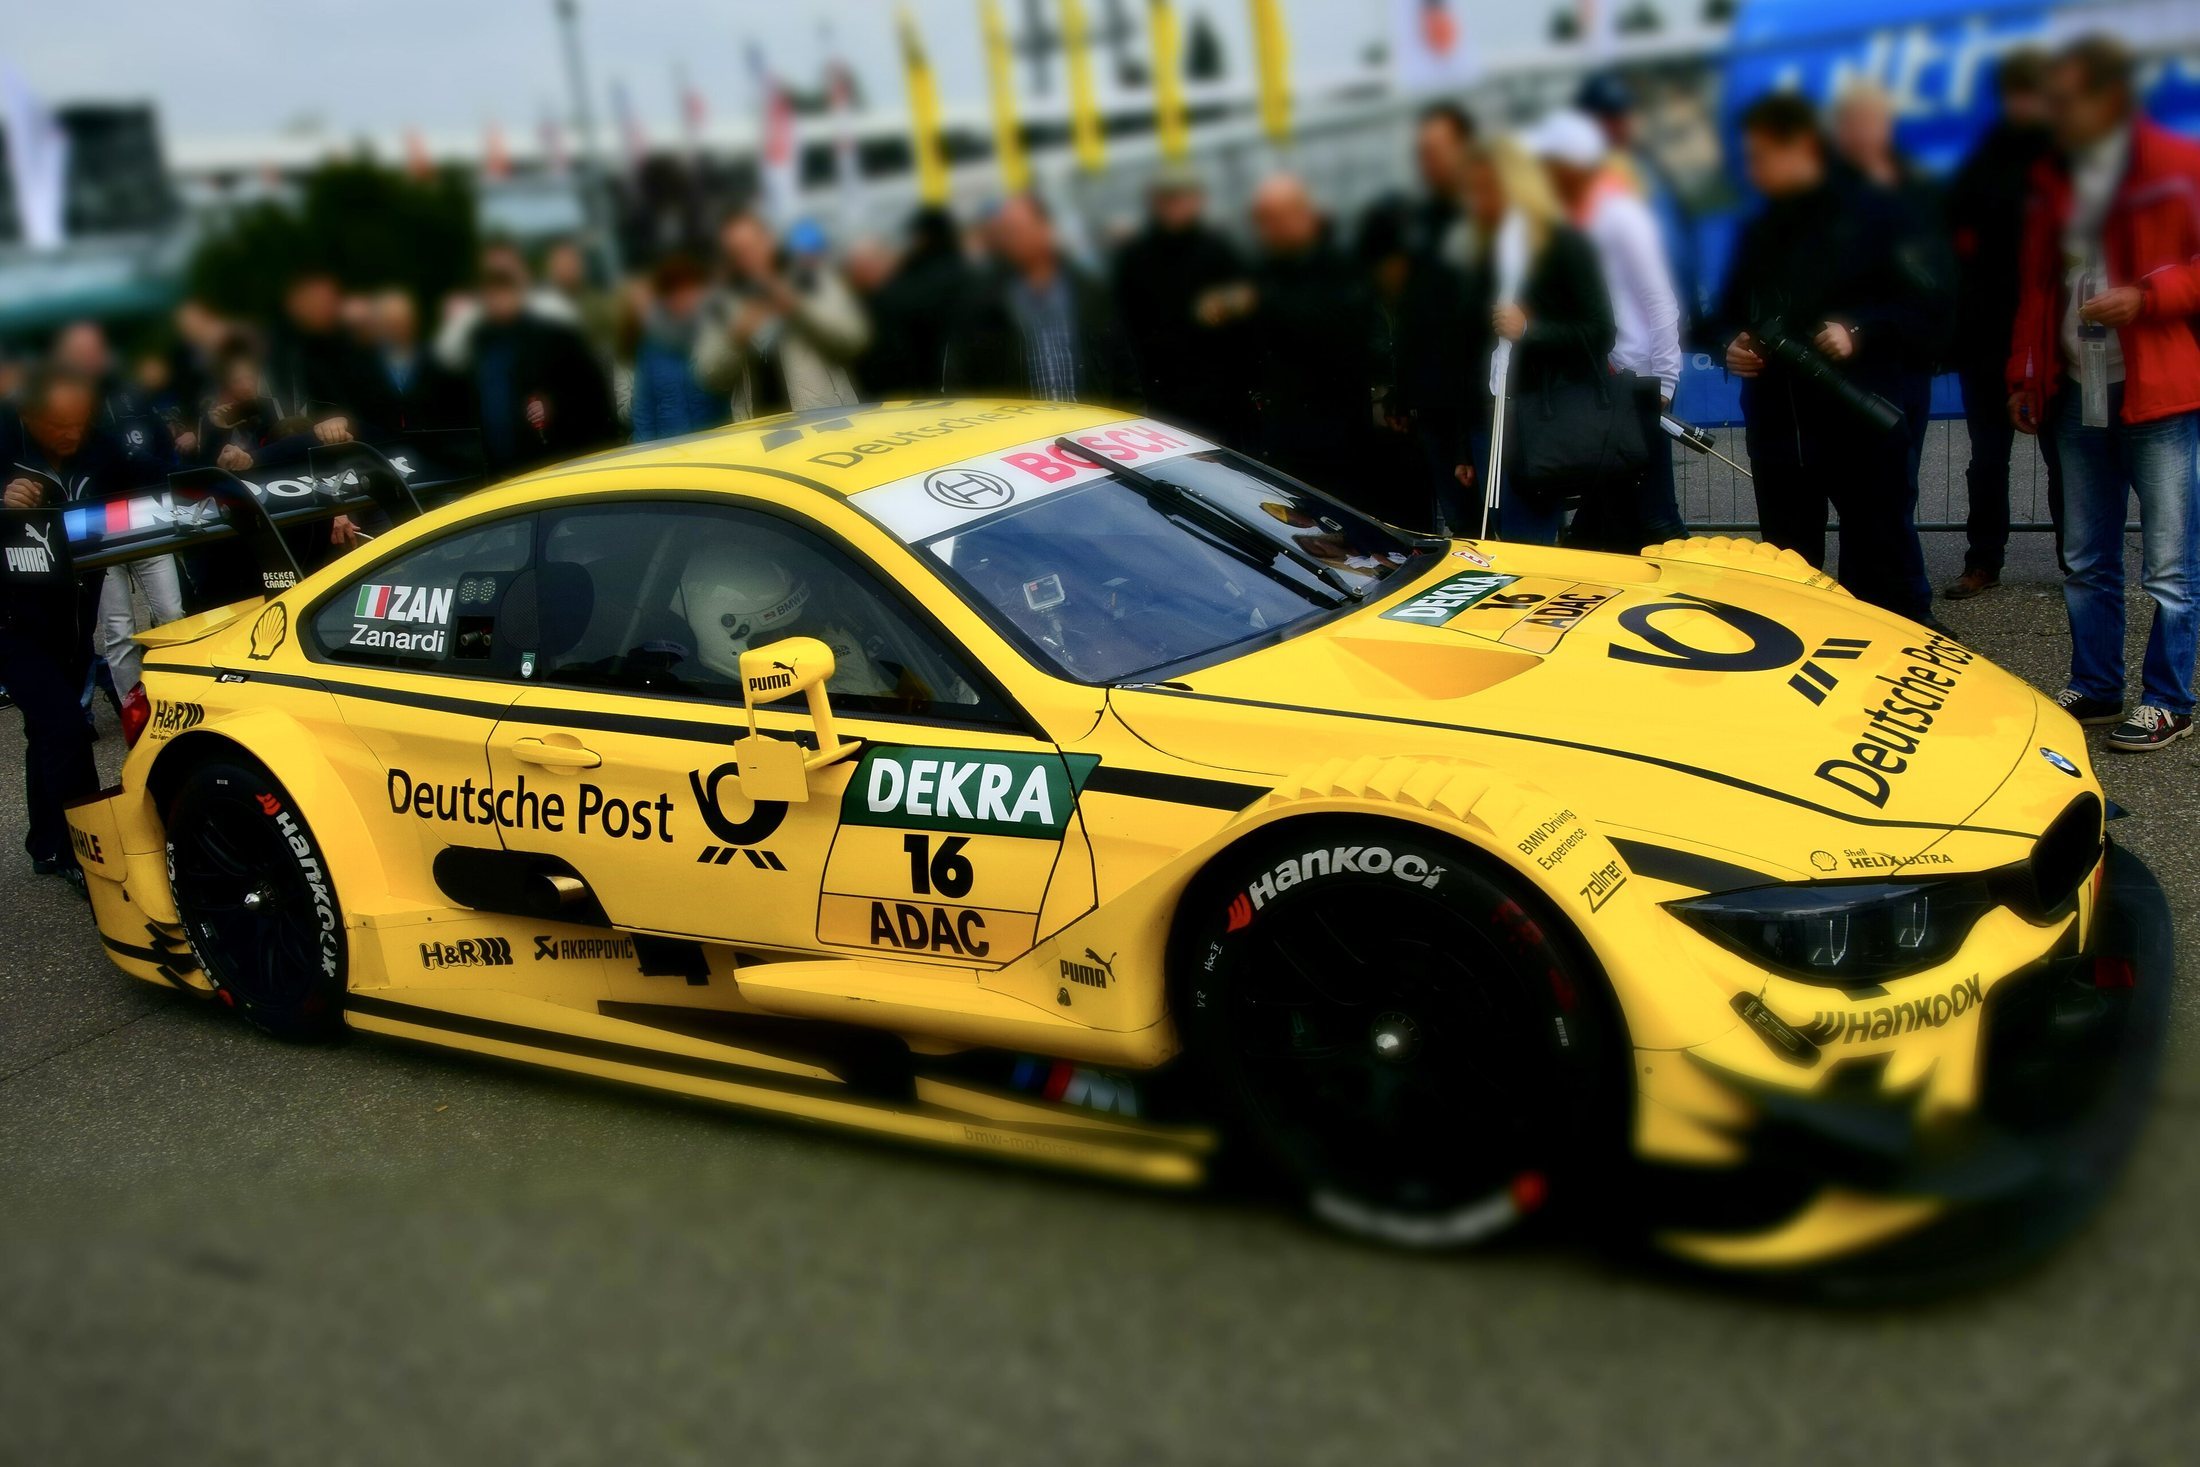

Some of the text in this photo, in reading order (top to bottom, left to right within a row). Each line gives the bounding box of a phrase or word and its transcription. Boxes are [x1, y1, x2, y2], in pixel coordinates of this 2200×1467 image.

[1000, 425, 1190, 484] BOSCH
[6, 547, 50, 572] PUMA
[263, 571, 295, 581] BECKER
[265, 580, 297, 589] CARBON
[1393, 573, 1513, 618] DEKRA
[1473, 592, 1547, 611] 16
[388, 586, 453, 624] ZAN
[1524, 593, 1607, 629] ADAC
[350, 624, 445, 653] Zanardi
[749, 673, 791, 692] PUMA
[1814, 632, 1974, 809] Deutsche Post
[388, 768, 674, 843] Deutsche Post
[867, 758, 1055, 825] DEKRA
[1517, 809, 1577, 856] BMW Driving
[1537, 827, 1587, 871] Experience
[903, 834, 974, 899] 16
[1844, 848, 1868, 857] Shell
[1848, 853, 1954, 869] HELIX ULTRA
[870, 901, 989, 958] ADAC
[1060, 959, 1107, 989] PUMA
